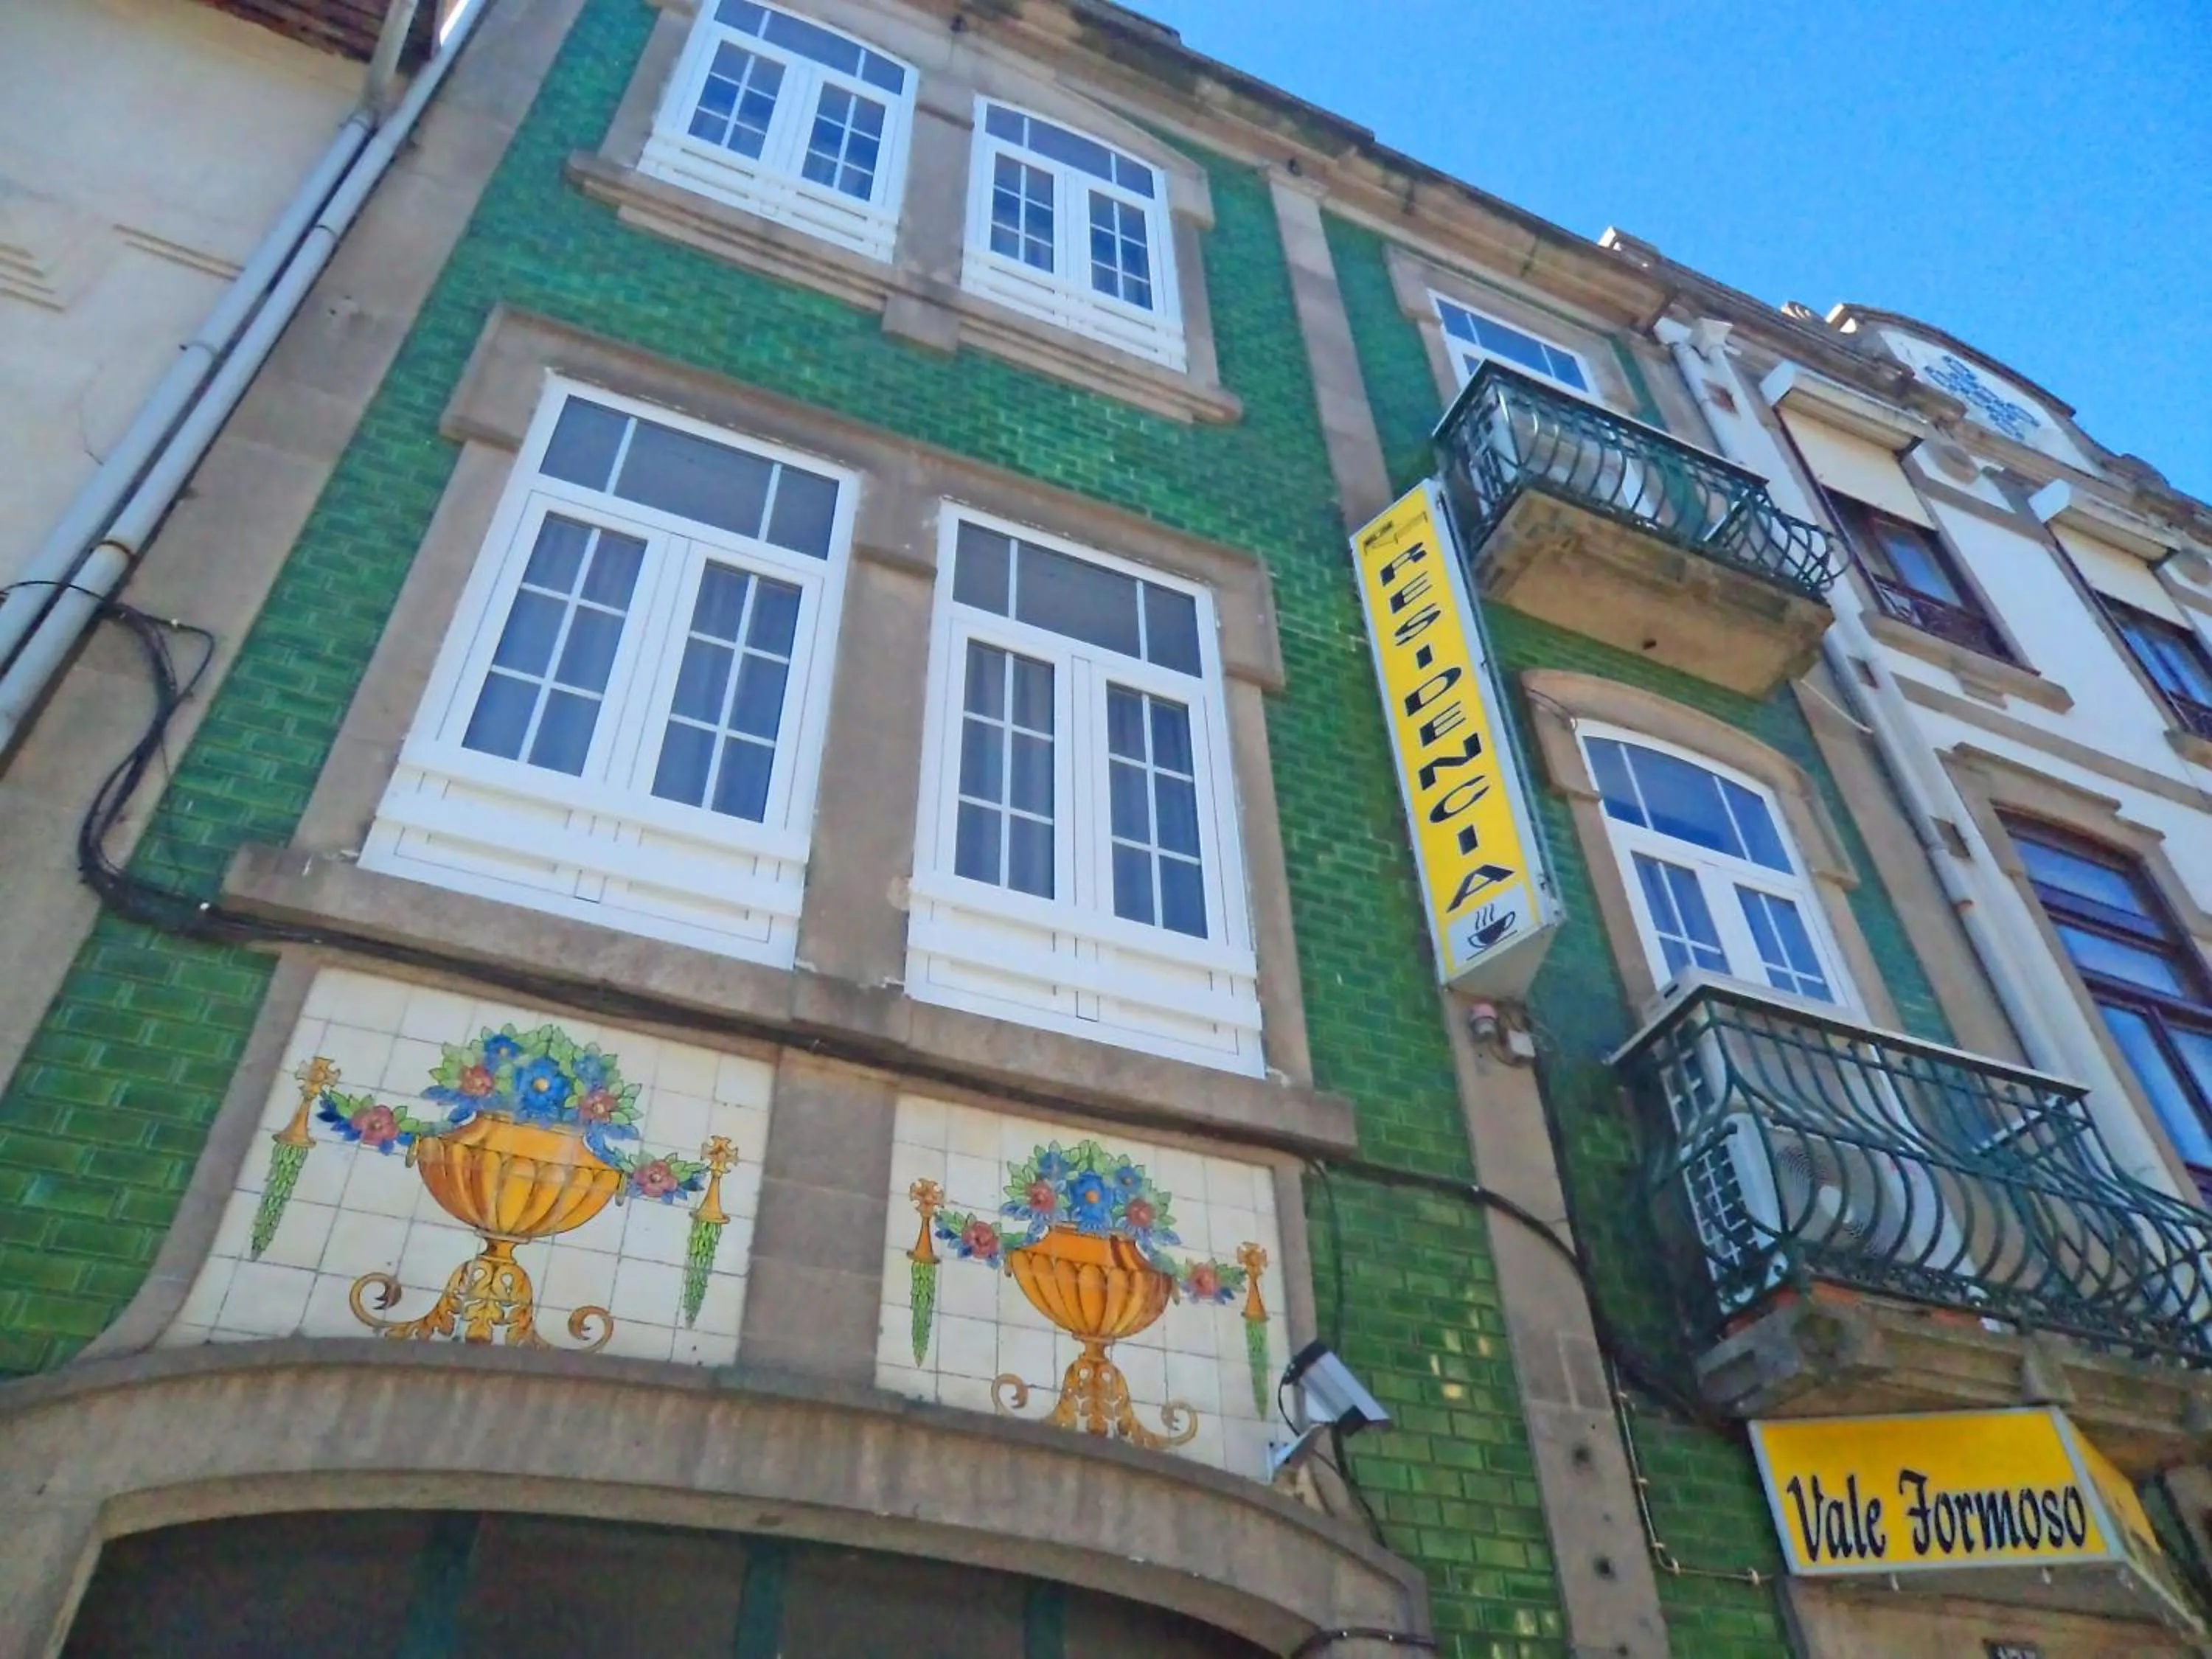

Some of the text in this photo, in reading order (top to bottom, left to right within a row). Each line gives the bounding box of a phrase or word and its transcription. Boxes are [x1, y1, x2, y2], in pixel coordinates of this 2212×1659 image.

[1381, 541, 1515, 914] RESIDENCIA
[1787, 1468, 2087, 1562] Vale Formoso
